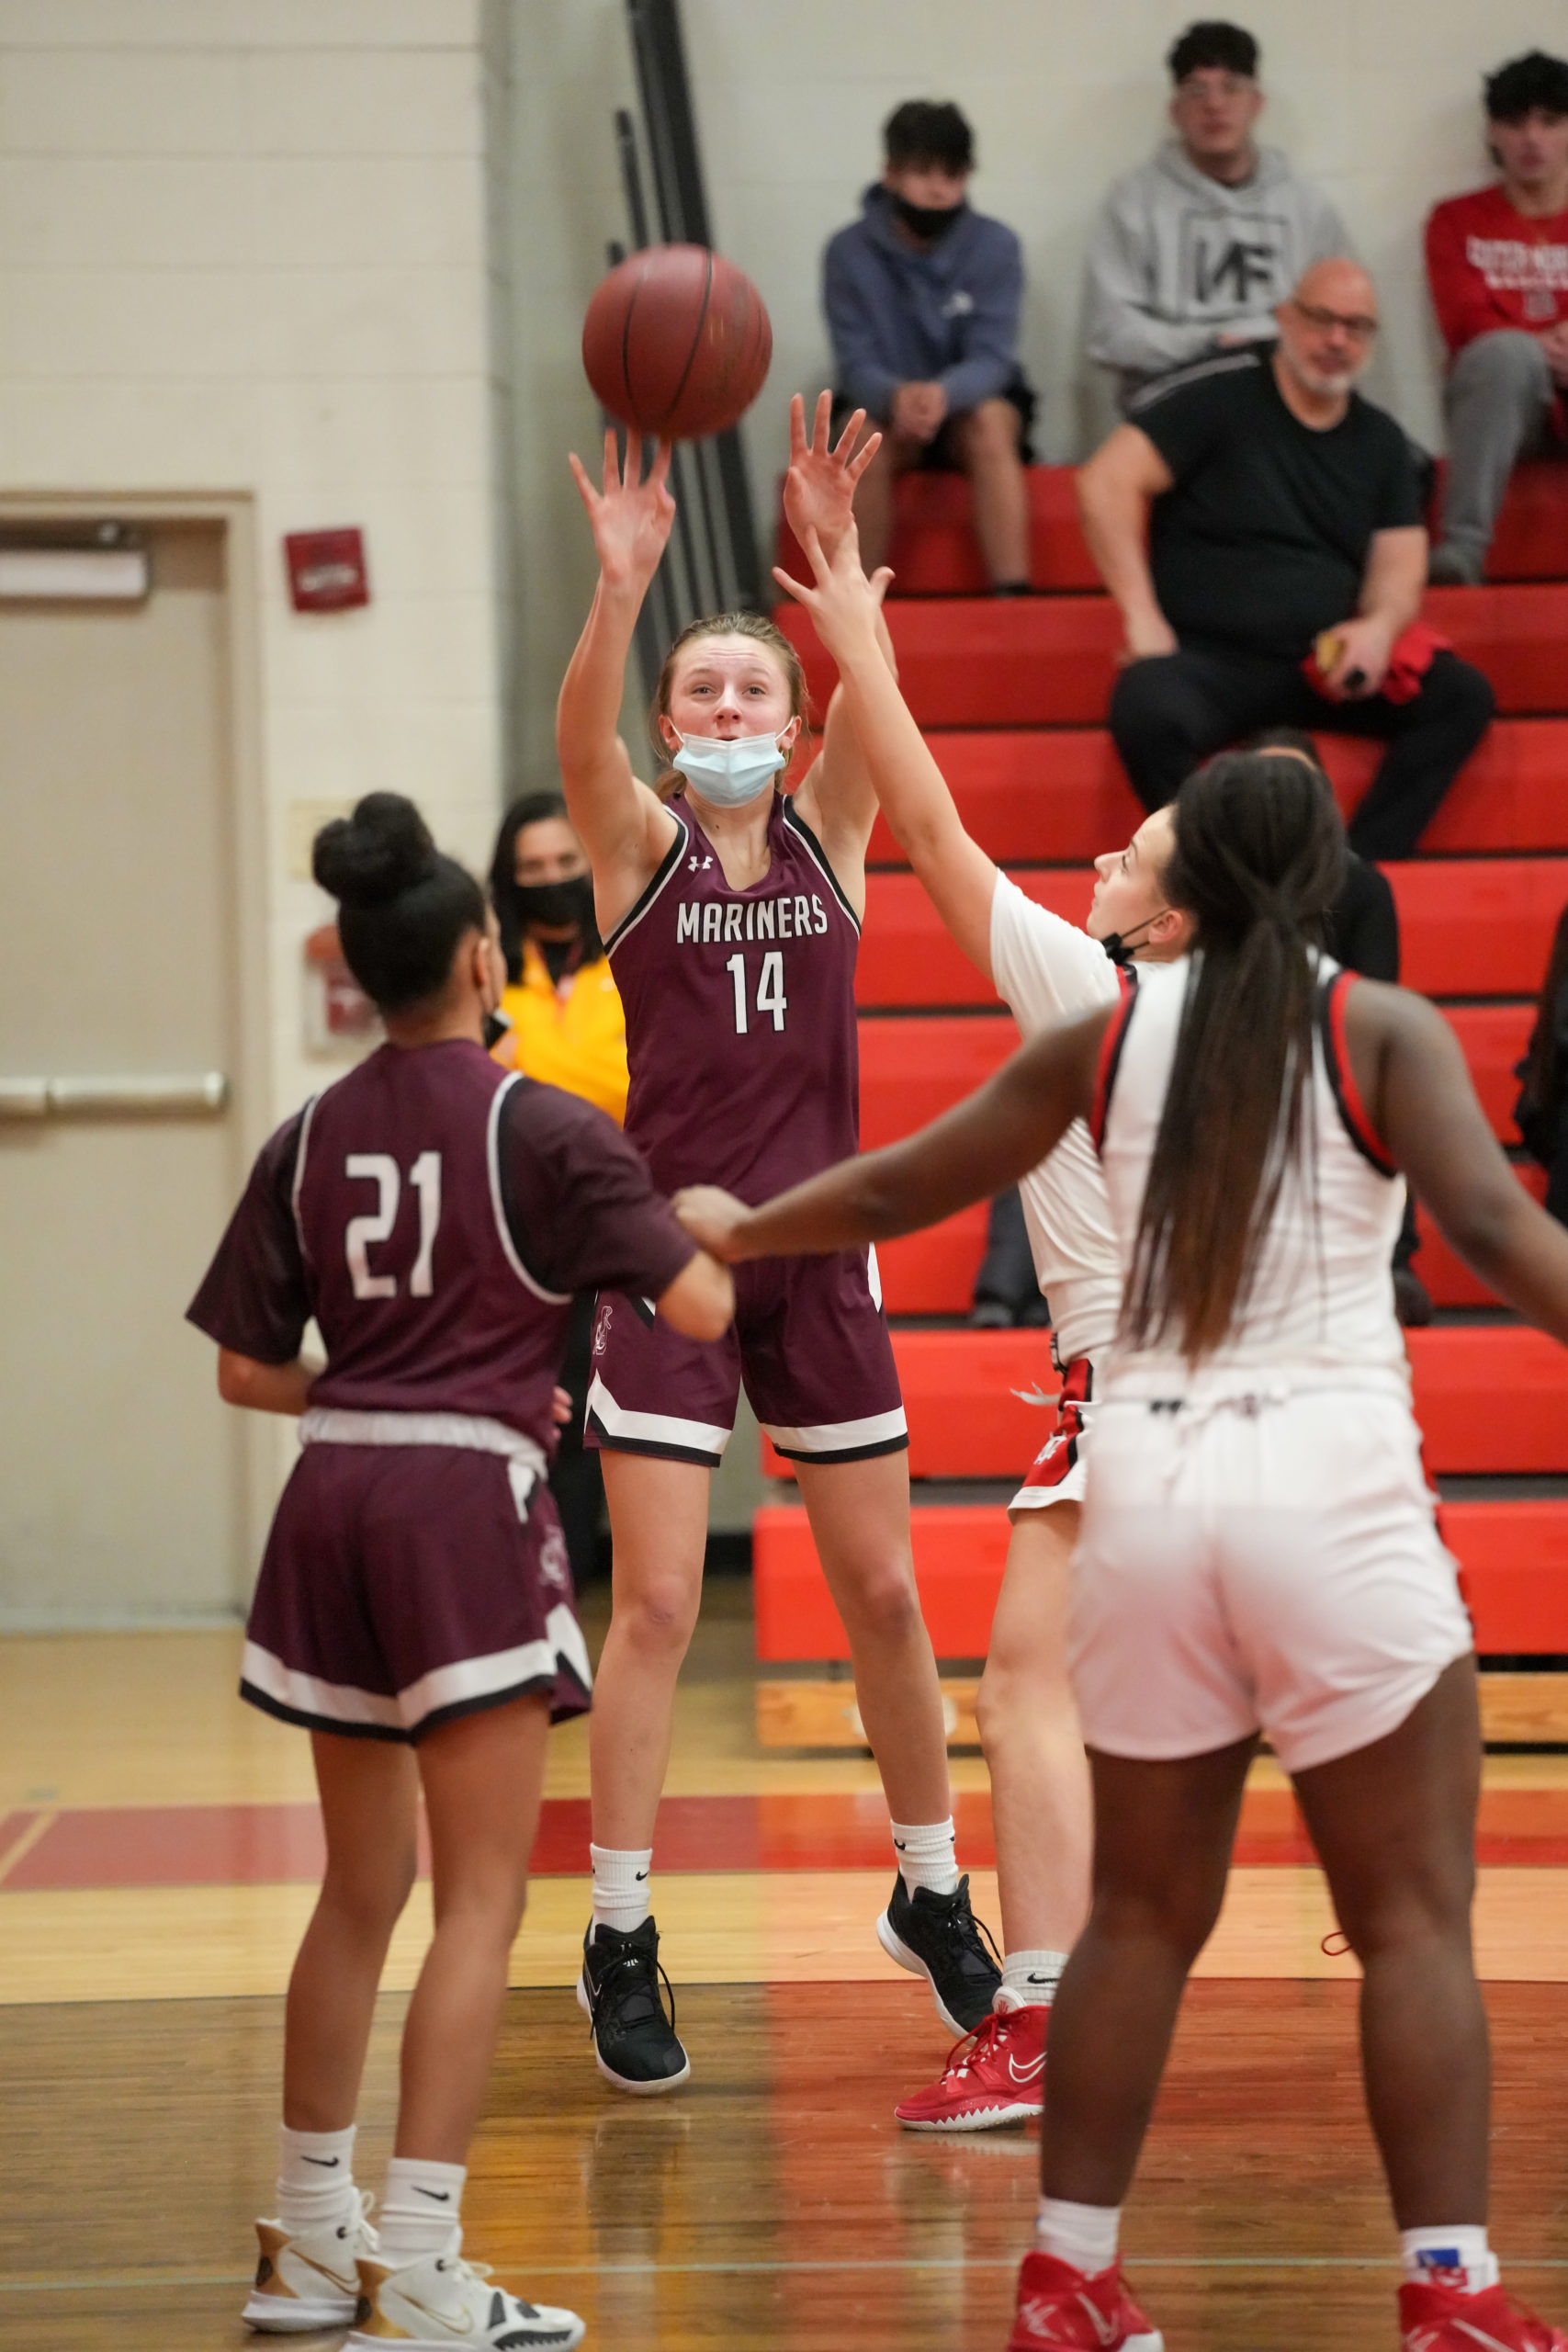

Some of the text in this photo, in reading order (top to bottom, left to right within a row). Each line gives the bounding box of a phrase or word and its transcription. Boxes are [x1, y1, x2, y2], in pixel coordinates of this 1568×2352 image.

[676, 893, 829, 944] MARINERS
[726, 950, 787, 1035] 14
[344, 1150, 442, 1300] 21
